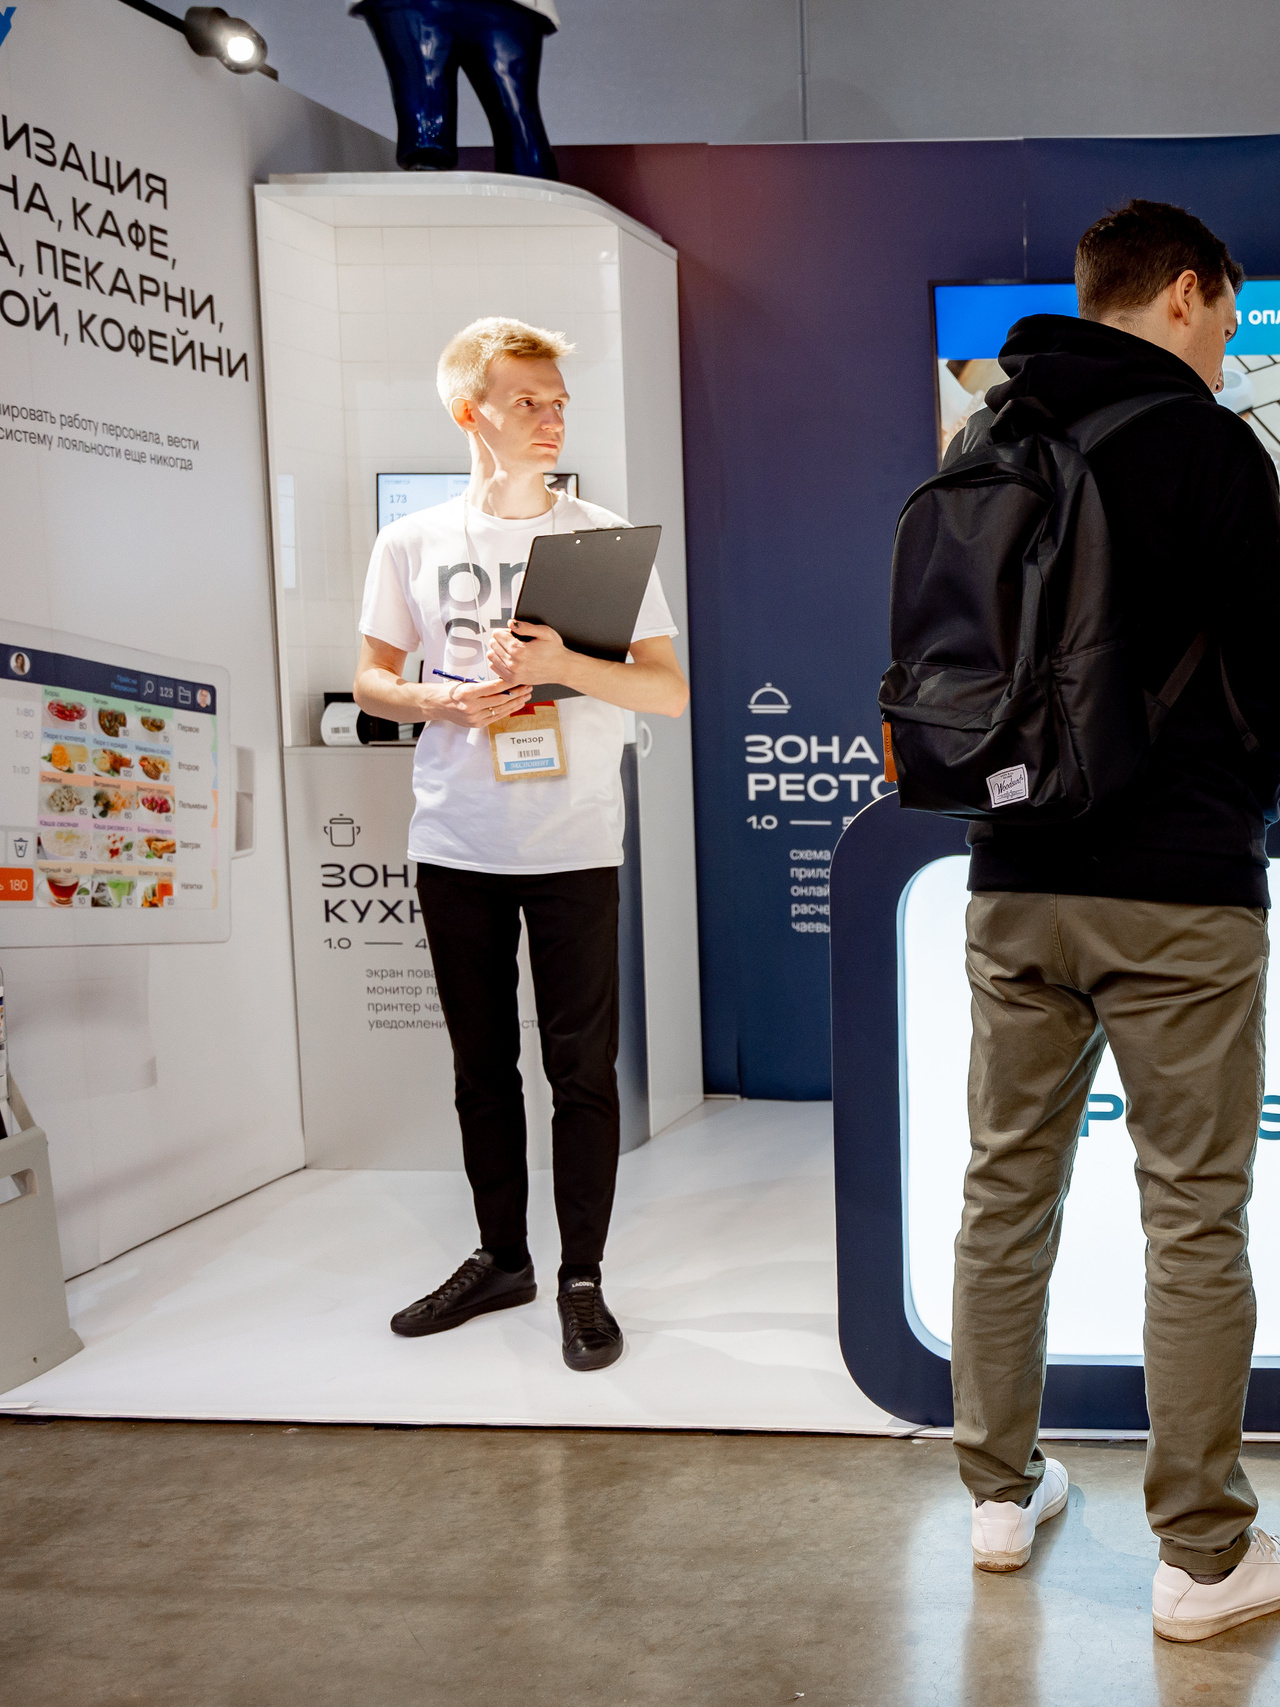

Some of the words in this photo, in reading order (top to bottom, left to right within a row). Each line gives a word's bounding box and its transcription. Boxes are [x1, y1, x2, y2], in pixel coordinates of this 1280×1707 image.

[1, 113, 168, 210] ИЗАЦИЯ
[72, 196, 177, 270] КАФЕ,
[36, 240, 224, 333] ПЕКАРНИ,
[0, 288, 69, 346] ОЙ,
[78, 309, 249, 382] КОФЕЙНИ
[60, 413, 99, 437] работу
[102, 422, 164, 448] персонала,
[167, 435, 200, 451] вести
[0, 427, 53, 451] систему
[57, 436, 122, 460] лояльности
[124, 448, 147, 464] еще
[149, 453, 193, 471] никогда
[390, 494, 407, 503] 173
[437, 561, 527, 622] pr
[159, 686, 174, 698] 123
[510, 736, 544, 745] Тензор
[744, 735, 879, 764] ЗОНА
[789, 850, 831, 861] схема
[320, 863, 417, 889] ЗОН
[9, 879, 28, 891] 180
[414, 938, 430, 950] 4
[366, 968, 403, 980] экран
[366, 985, 422, 997] монитор
[367, 1002, 421, 1014] принтер
[425, 1003, 444, 1012] че
[368, 1019, 447, 1031] уведомлени
